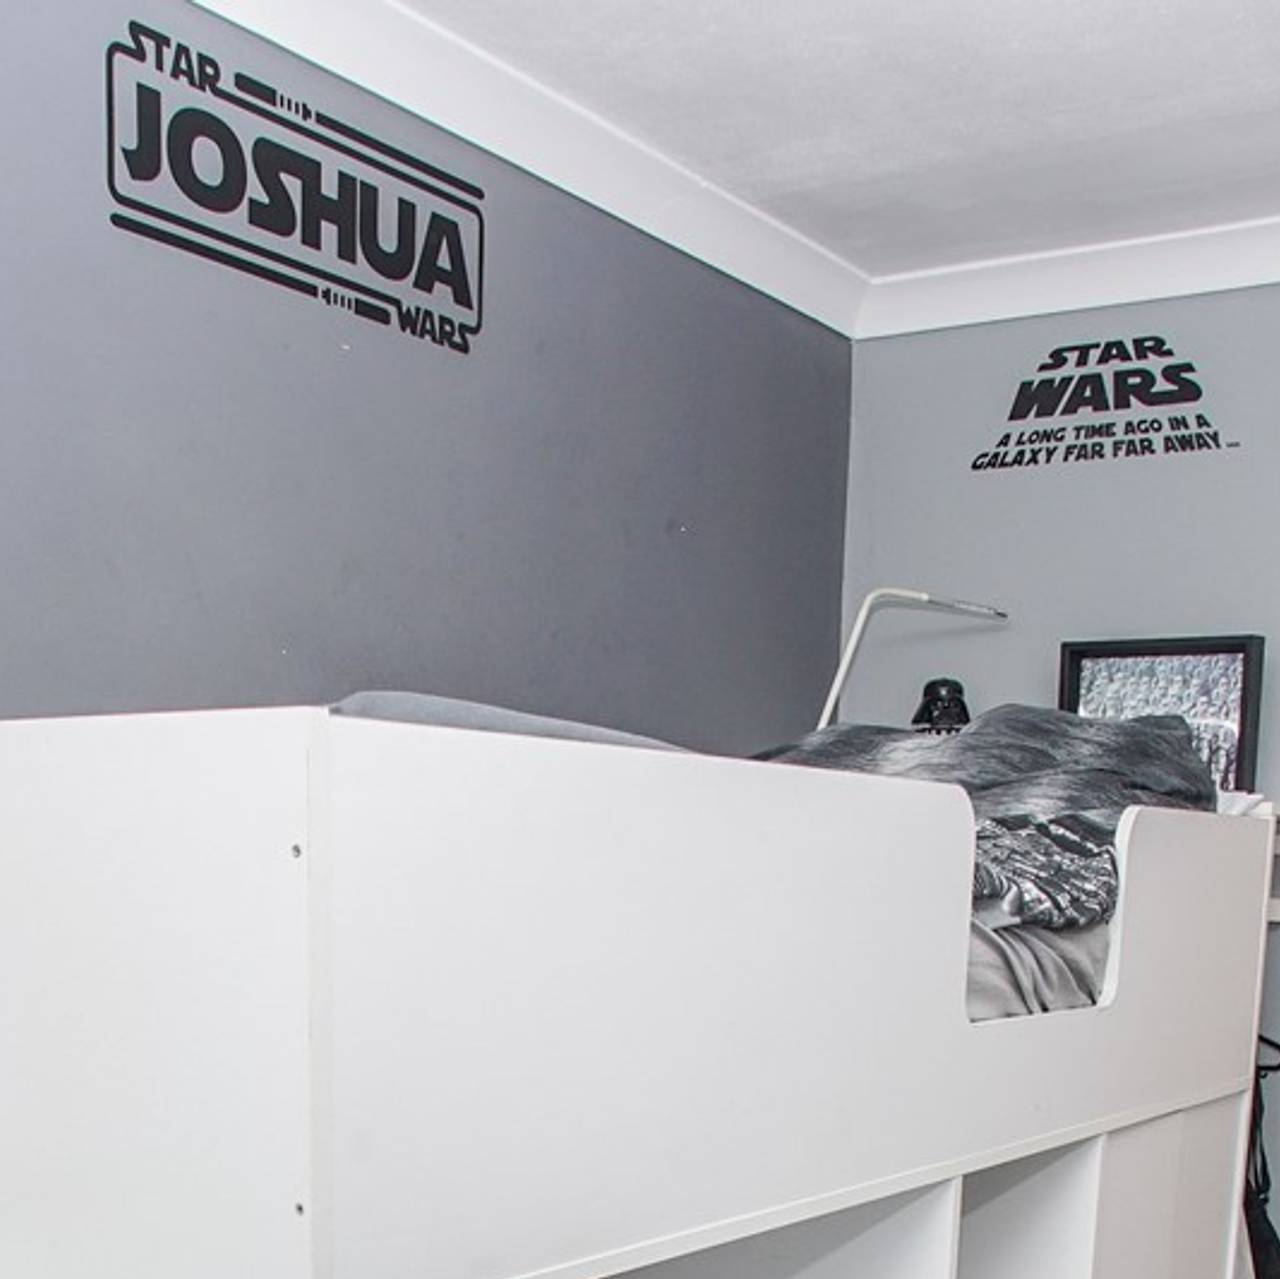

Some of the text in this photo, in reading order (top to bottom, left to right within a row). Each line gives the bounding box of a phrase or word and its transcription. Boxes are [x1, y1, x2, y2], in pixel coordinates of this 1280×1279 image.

[127, 19, 222, 95] STAR
[120, 82, 474, 310] JOSHUA
[395, 302, 475, 354] WARS
[1036, 334, 1175, 372] STAR
[1007, 362, 1203, 422] WARS
[970, 446, 1058, 471] GALAXY
[1062, 442, 1106, 463] FAR
[1112, 438, 1157, 459] FAR
[996, 413, 1212, 449] A LONG TIME AGO IN A
